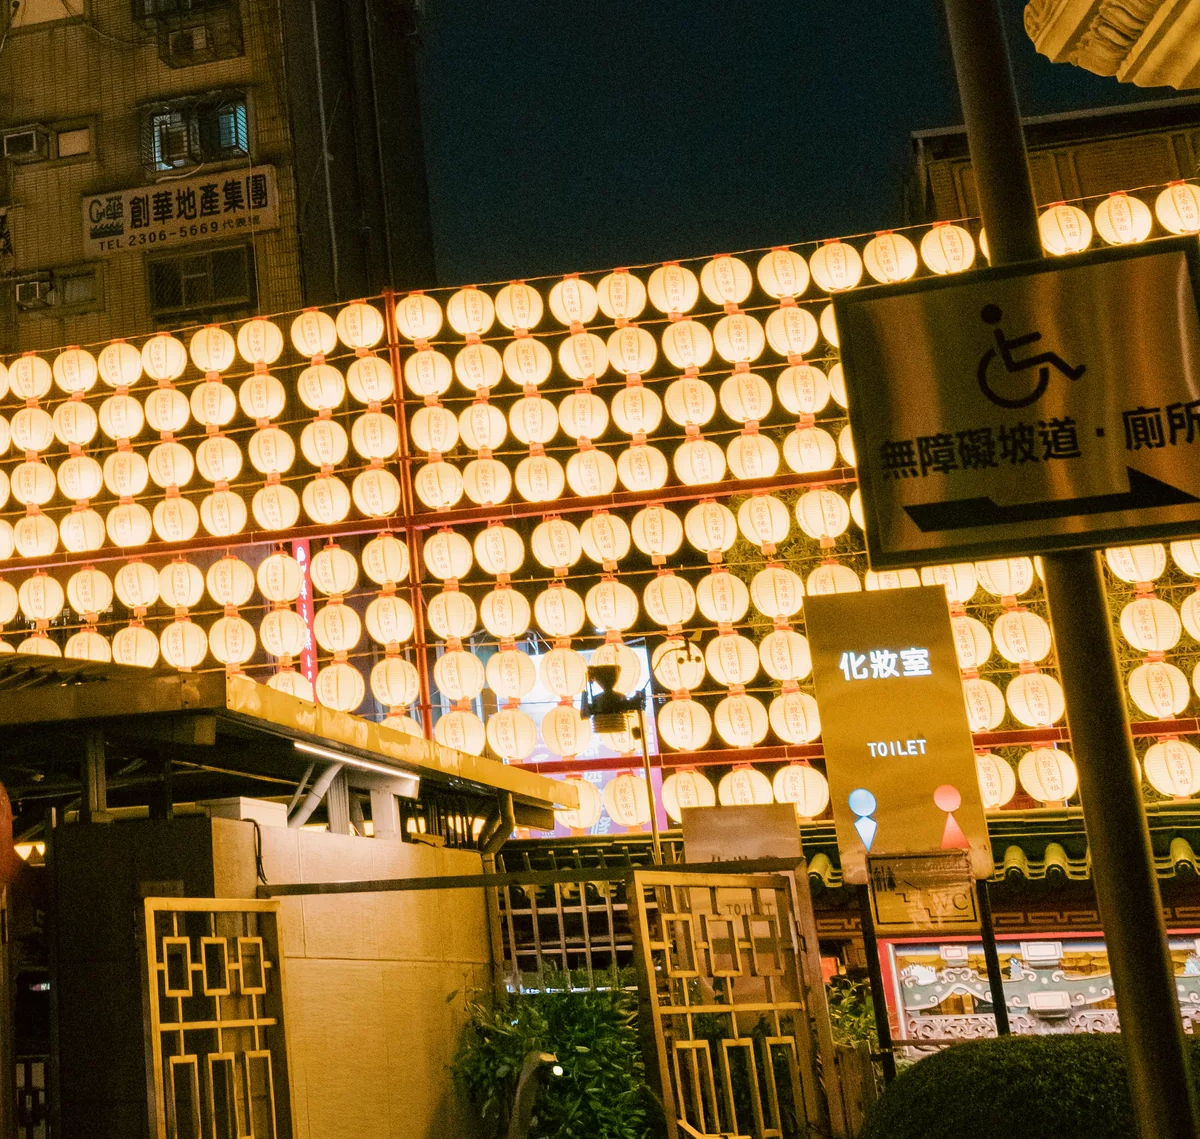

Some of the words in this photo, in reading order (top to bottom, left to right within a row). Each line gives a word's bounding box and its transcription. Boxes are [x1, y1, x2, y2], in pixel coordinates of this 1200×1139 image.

[129, 173, 269, 230] 創華地產集團
[98, 238, 122, 252] TEL
[128, 222, 219, 247] 2306-5669
[839, 646, 933, 682] 化妝室
[866, 738, 928, 758] TOILET
